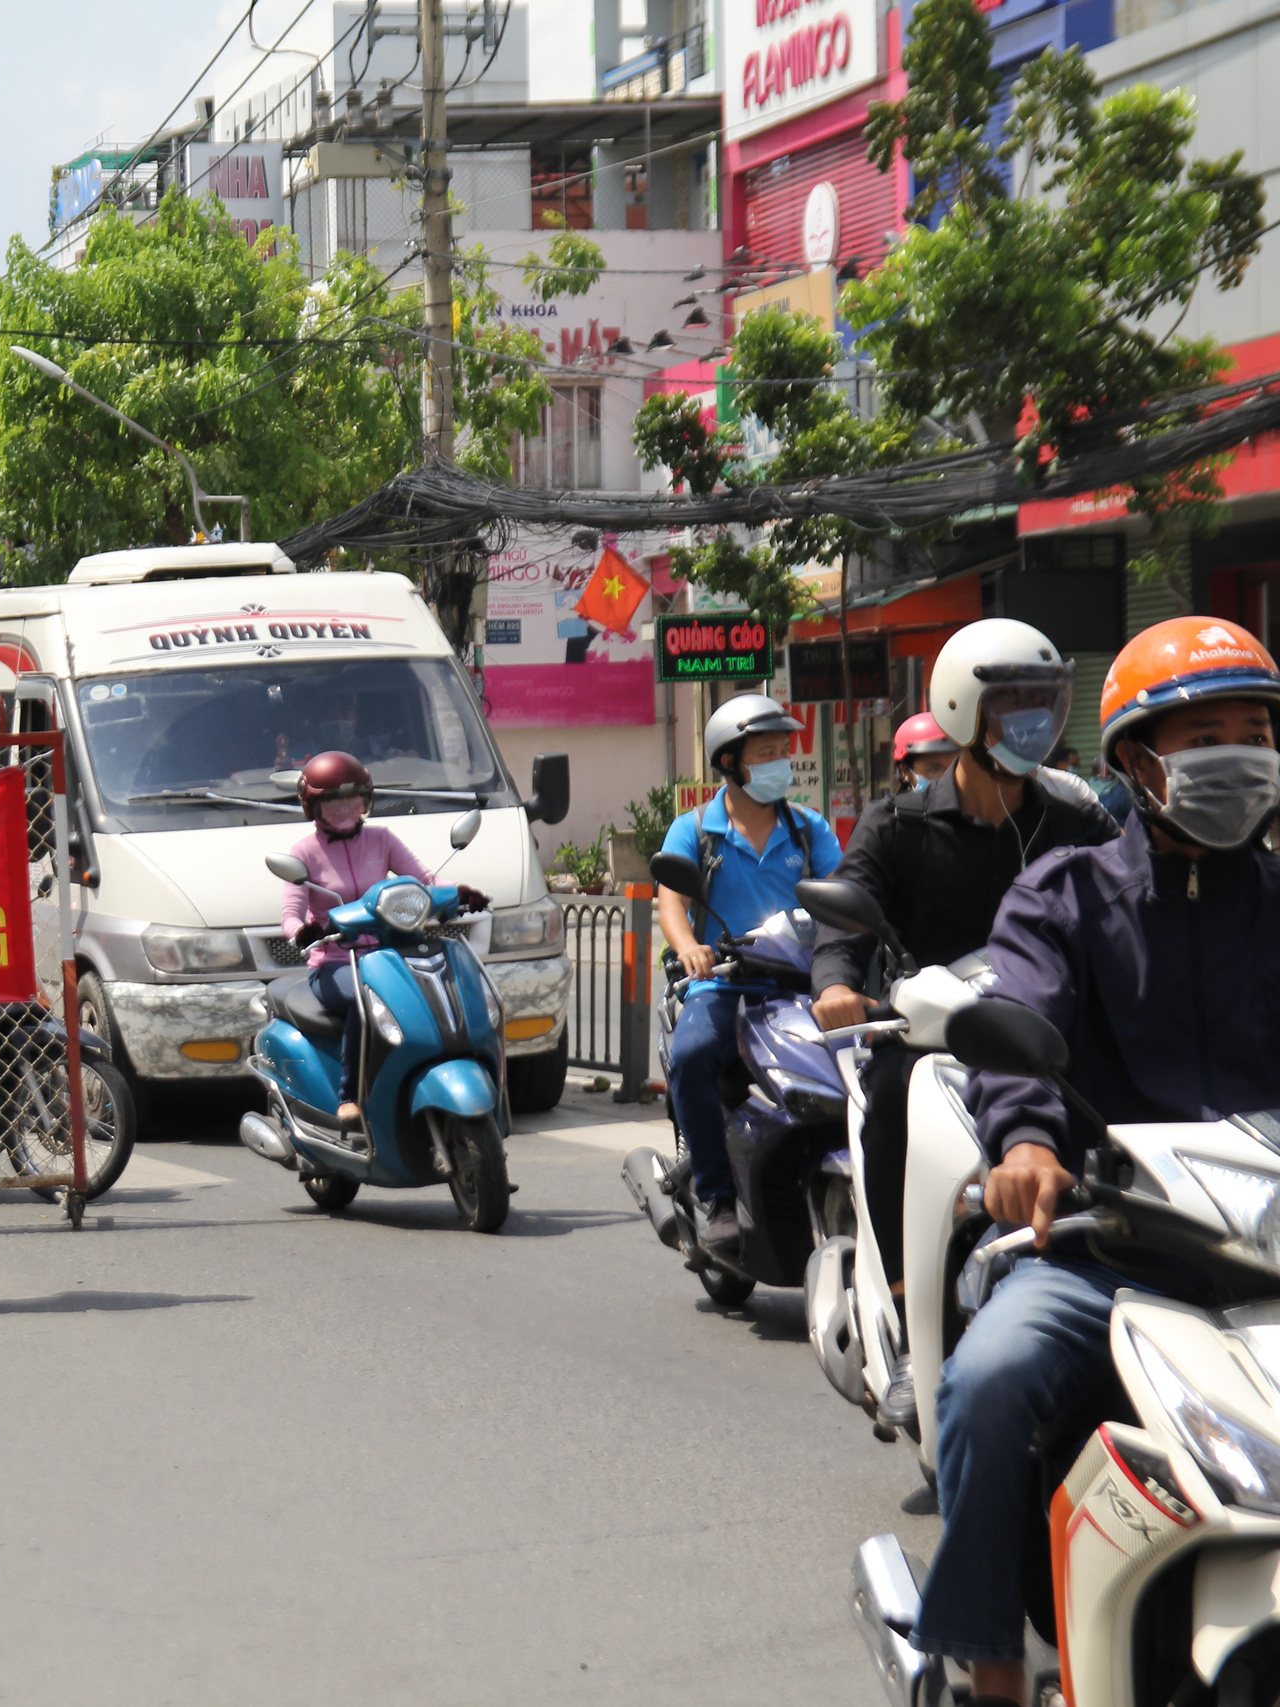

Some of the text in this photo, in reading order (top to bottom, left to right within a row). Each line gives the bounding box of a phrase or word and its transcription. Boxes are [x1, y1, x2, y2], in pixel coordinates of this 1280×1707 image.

[743, 10, 852, 108] FLAMINGO
[209, 155, 269, 199] NHA
[511, 303, 559, 317] KHOA
[488, 564, 540, 582] MINGO
[149, 624, 260, 651] QUỲNH
[666, 620, 765, 655] QUẢNG CÁO
[677, 653, 755, 673] NAM TRÍ
[1189, 646, 1254, 663] AhaMove
[526, 686, 575, 697] FLAMINGO
[681, 787, 697, 809] IN
